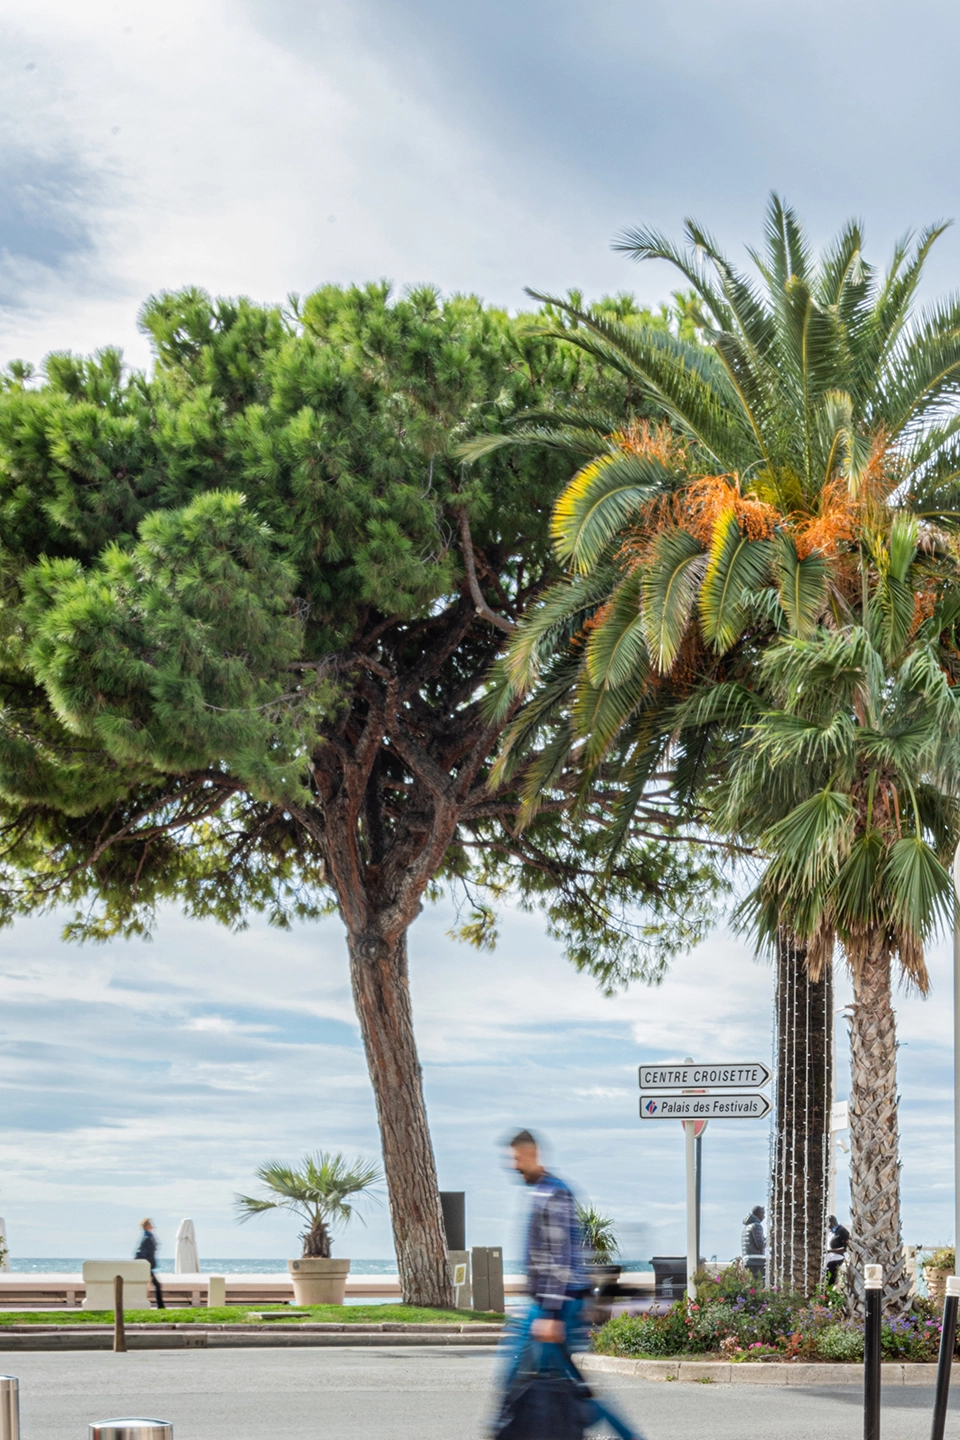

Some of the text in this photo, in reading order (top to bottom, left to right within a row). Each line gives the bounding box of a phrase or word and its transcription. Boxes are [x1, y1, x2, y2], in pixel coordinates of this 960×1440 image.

[644, 1069, 758, 1083] CENTRE CROISETTE
[661, 1100, 758, 1113] Palais des Festivals
